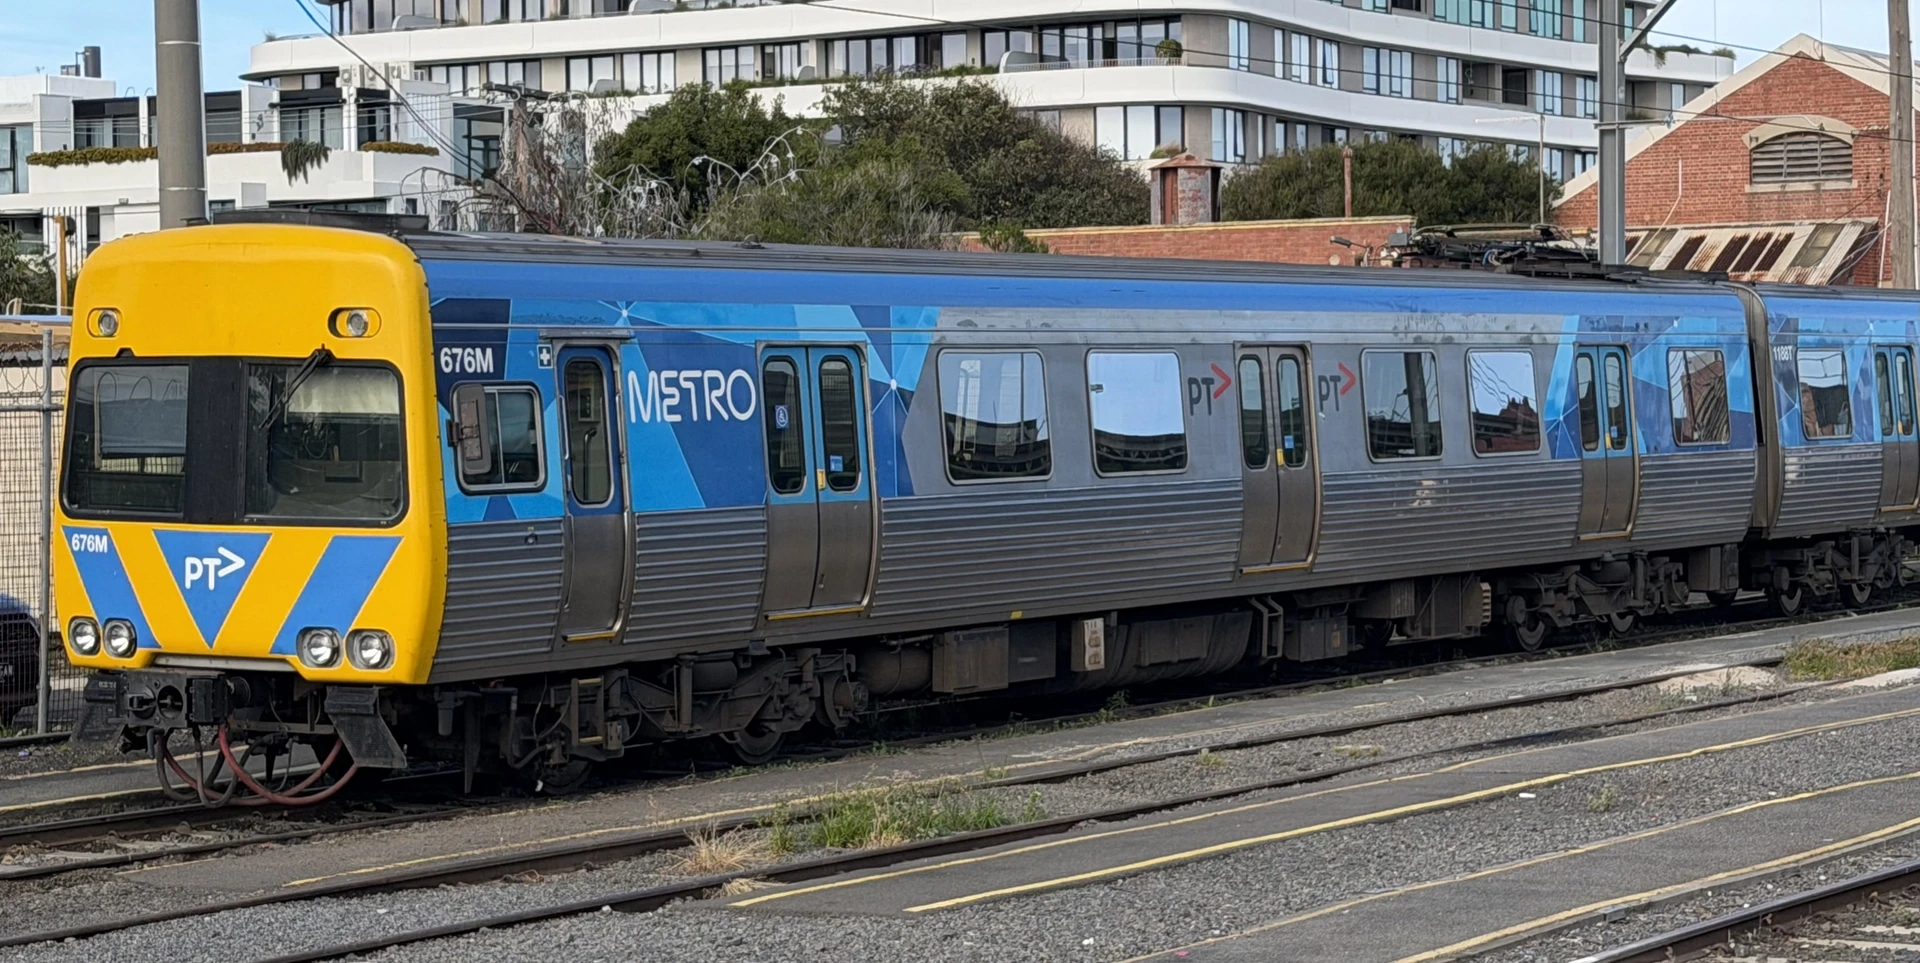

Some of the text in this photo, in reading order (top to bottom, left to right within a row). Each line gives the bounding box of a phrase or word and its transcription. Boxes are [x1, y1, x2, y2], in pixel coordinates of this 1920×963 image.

[440, 347, 494, 373] 676M
[1772, 345, 1793, 361] 1188T
[628, 368, 756, 423] METRO
[1187, 377, 1215, 416] PT
[1318, 375, 1342, 412] PT
[71, 531, 108, 553] 676M
[184, 555, 221, 591] PT
